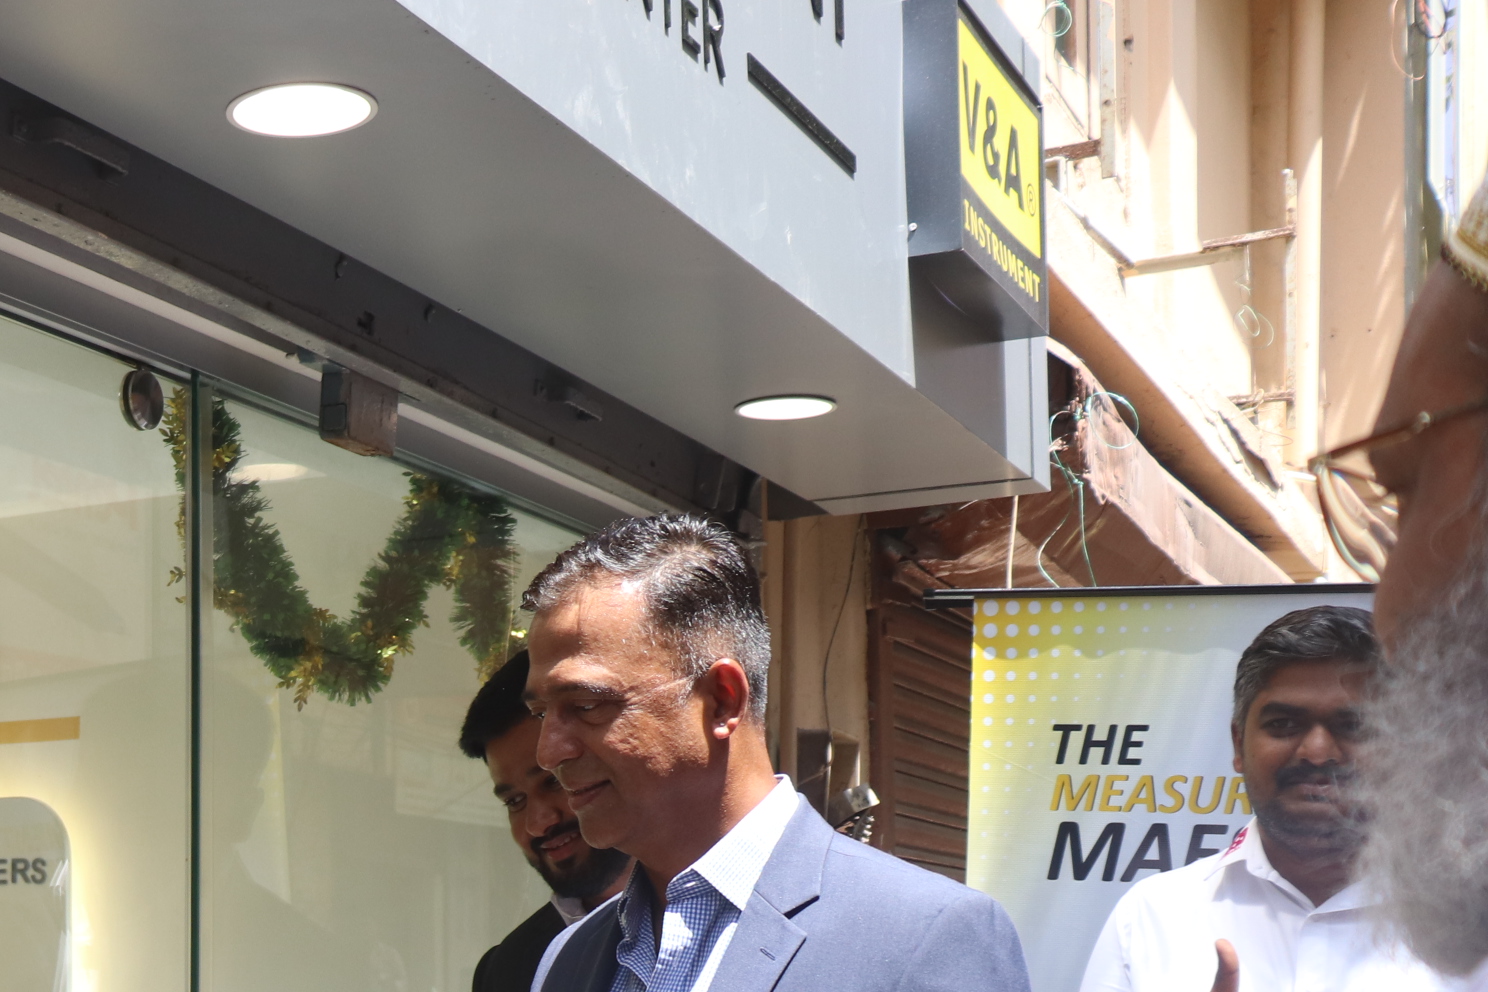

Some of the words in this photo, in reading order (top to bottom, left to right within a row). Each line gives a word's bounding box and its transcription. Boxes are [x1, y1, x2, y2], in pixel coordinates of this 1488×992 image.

[962, 60, 1026, 212] V&A
[964, 199, 1040, 302] INSTRUMENT
[1052, 724, 1150, 766] THE
[1049, 774, 1254, 815] MEASUR
[1047, 821, 1246, 882] MAE
